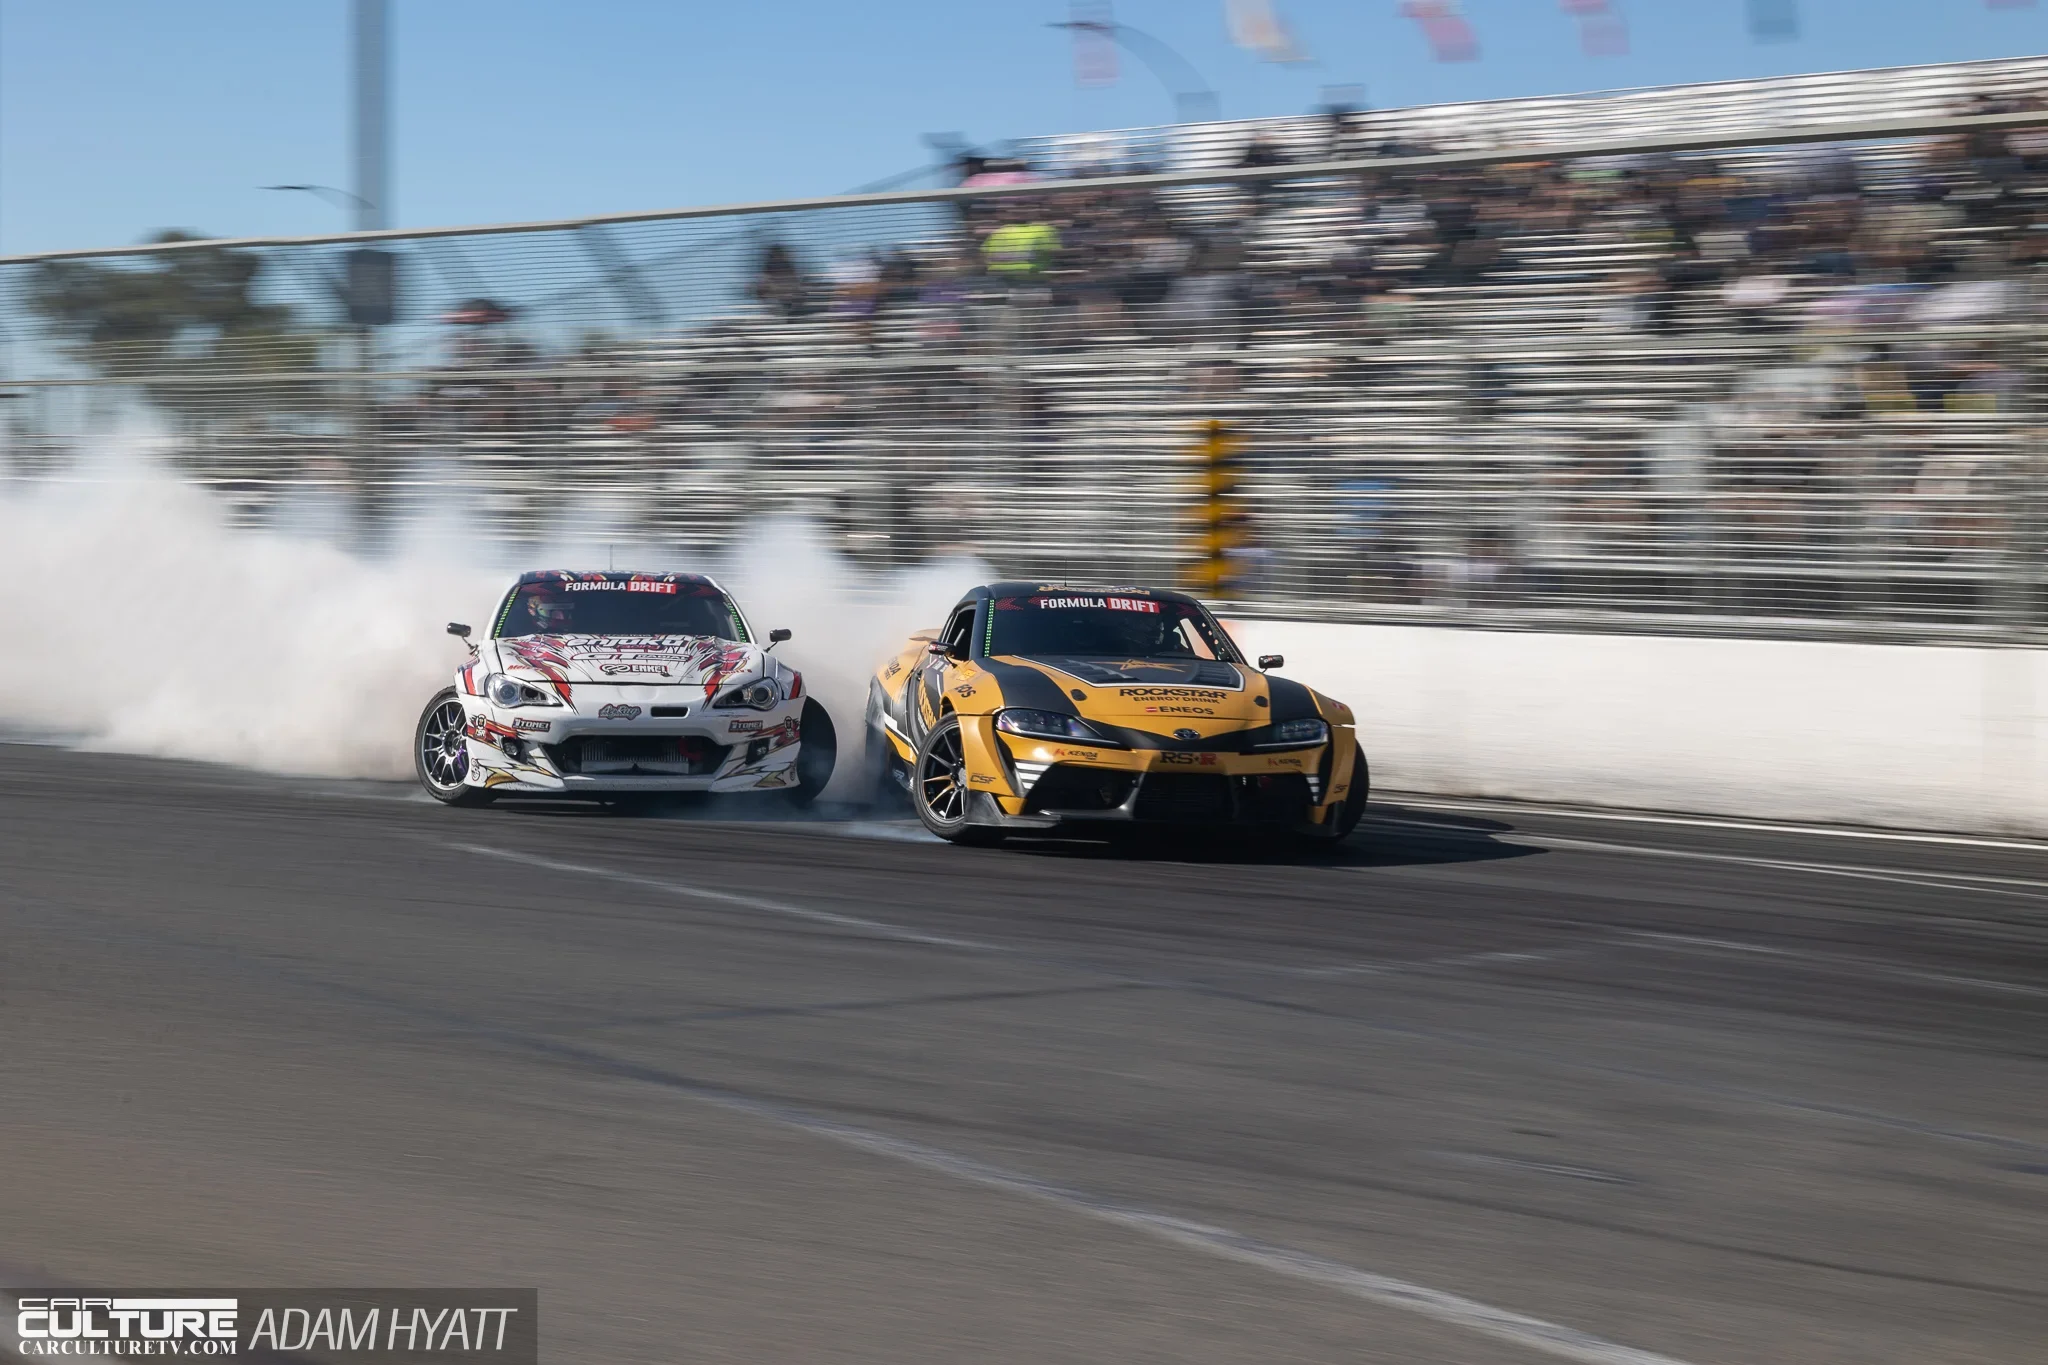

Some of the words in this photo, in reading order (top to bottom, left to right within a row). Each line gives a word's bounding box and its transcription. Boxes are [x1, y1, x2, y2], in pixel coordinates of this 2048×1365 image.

[565, 581, 627, 592] FORMULA
[629, 582, 674, 593] DRIFT
[1040, 597, 1107, 609] FORMULA
[1110, 598, 1156, 613] DRIFT
[632, 664, 666, 674] ENKEI
[1120, 688, 1227, 699] ROCKSTAR
[1159, 706, 1215, 715] ENEOS
[520, 720, 550, 729] TOMEI
[970, 774, 996, 784] CSF
